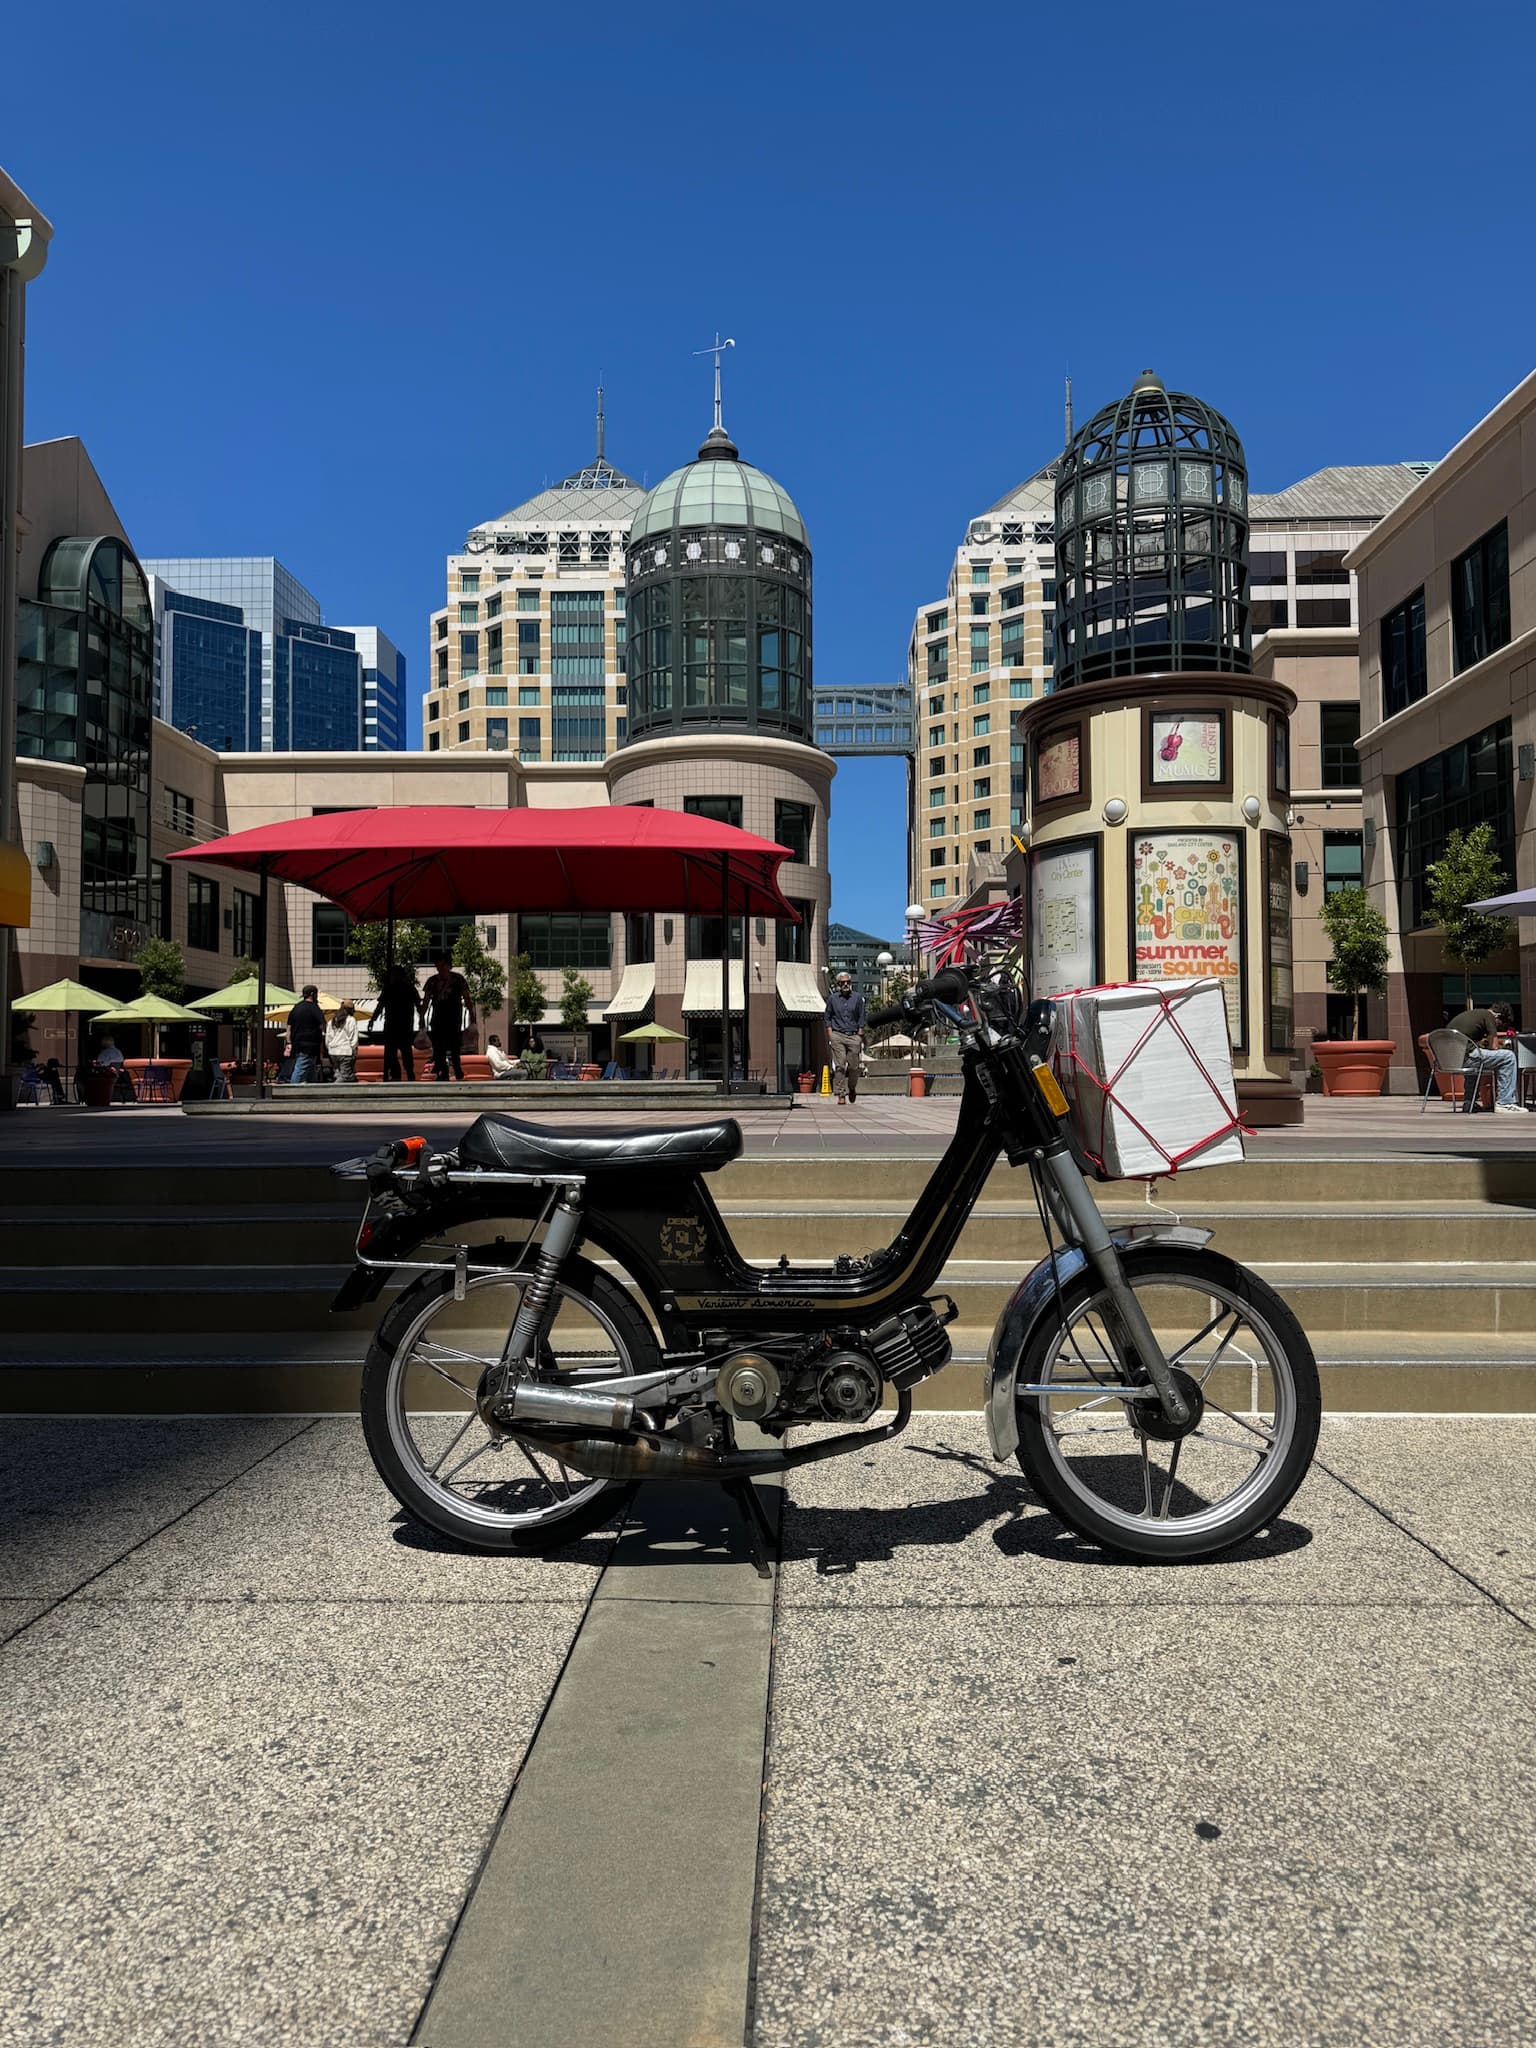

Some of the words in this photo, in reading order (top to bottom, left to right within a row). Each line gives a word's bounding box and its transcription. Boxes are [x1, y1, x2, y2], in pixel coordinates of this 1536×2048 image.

[1159, 762, 1206, 777] MUSIC
[1207, 757, 1217, 777] CITY
[1042, 779, 1070, 797] FOOD
[1136, 945, 1228, 960] summer
[1163, 956, 1238, 976] sounds
